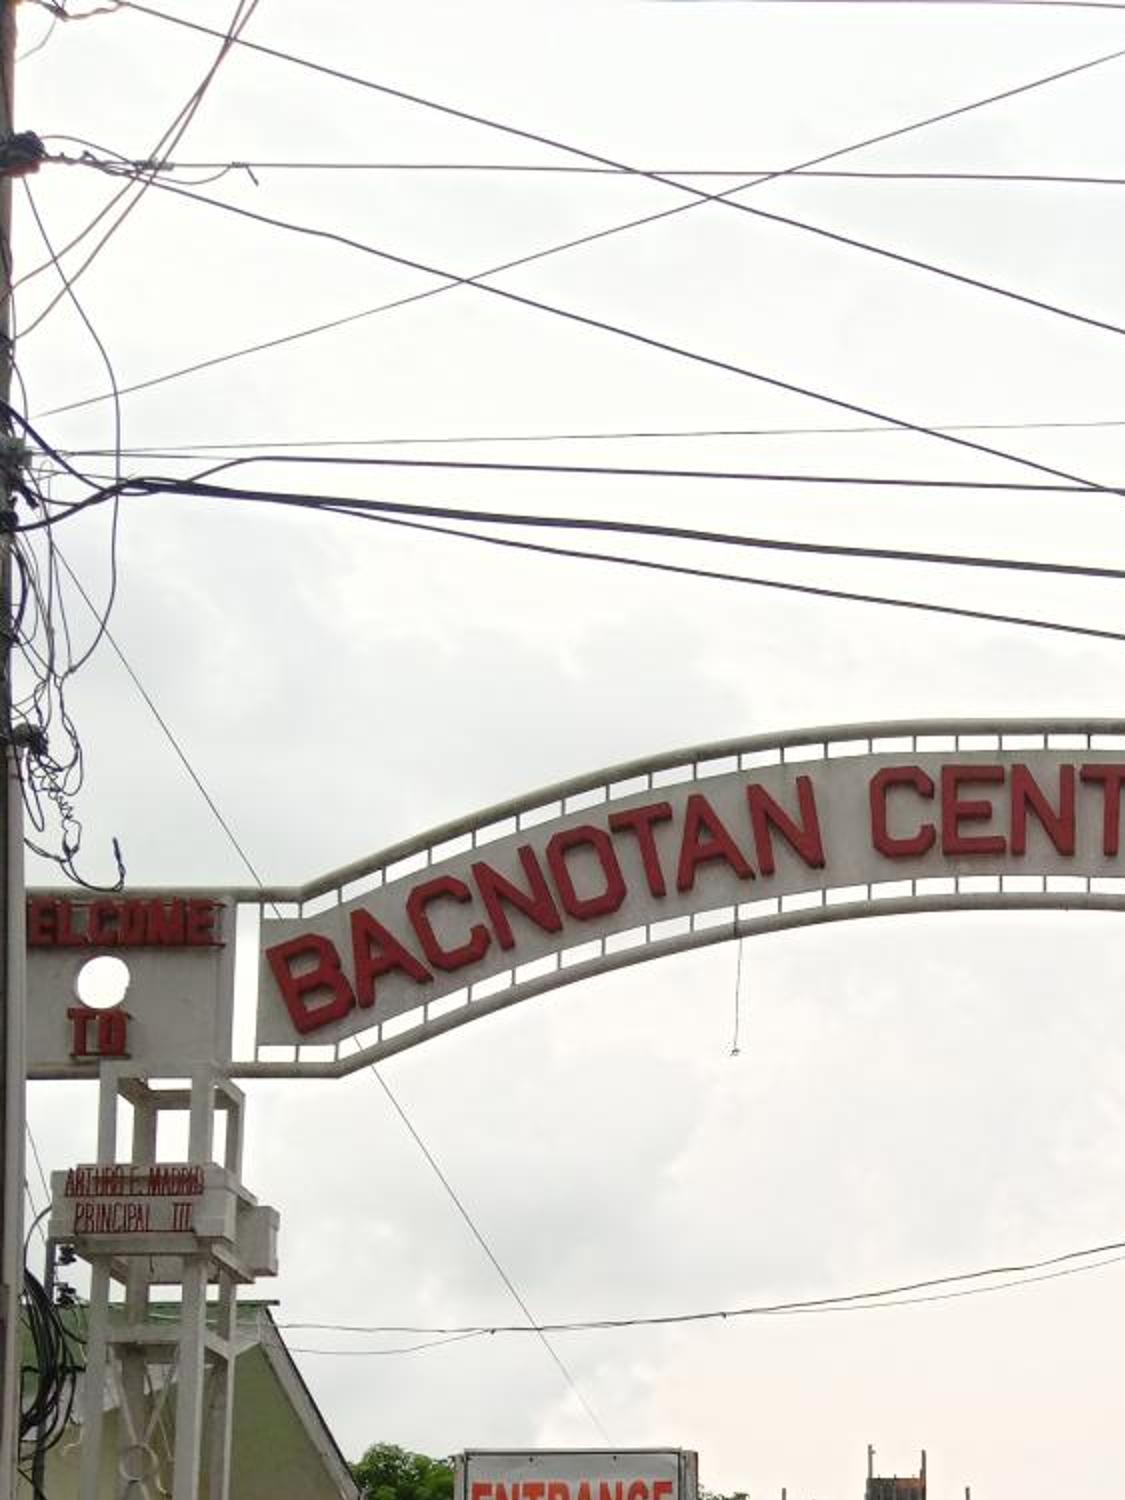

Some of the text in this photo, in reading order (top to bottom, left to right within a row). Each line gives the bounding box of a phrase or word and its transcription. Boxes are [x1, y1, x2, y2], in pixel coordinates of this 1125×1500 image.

[26, 897, 222, 947] ELCOME
[266, 775, 826, 1036] BACNOTAN
[67, 1008, 130, 1058] TO
[74, 1202, 151, 1233] PRINCIPAL
